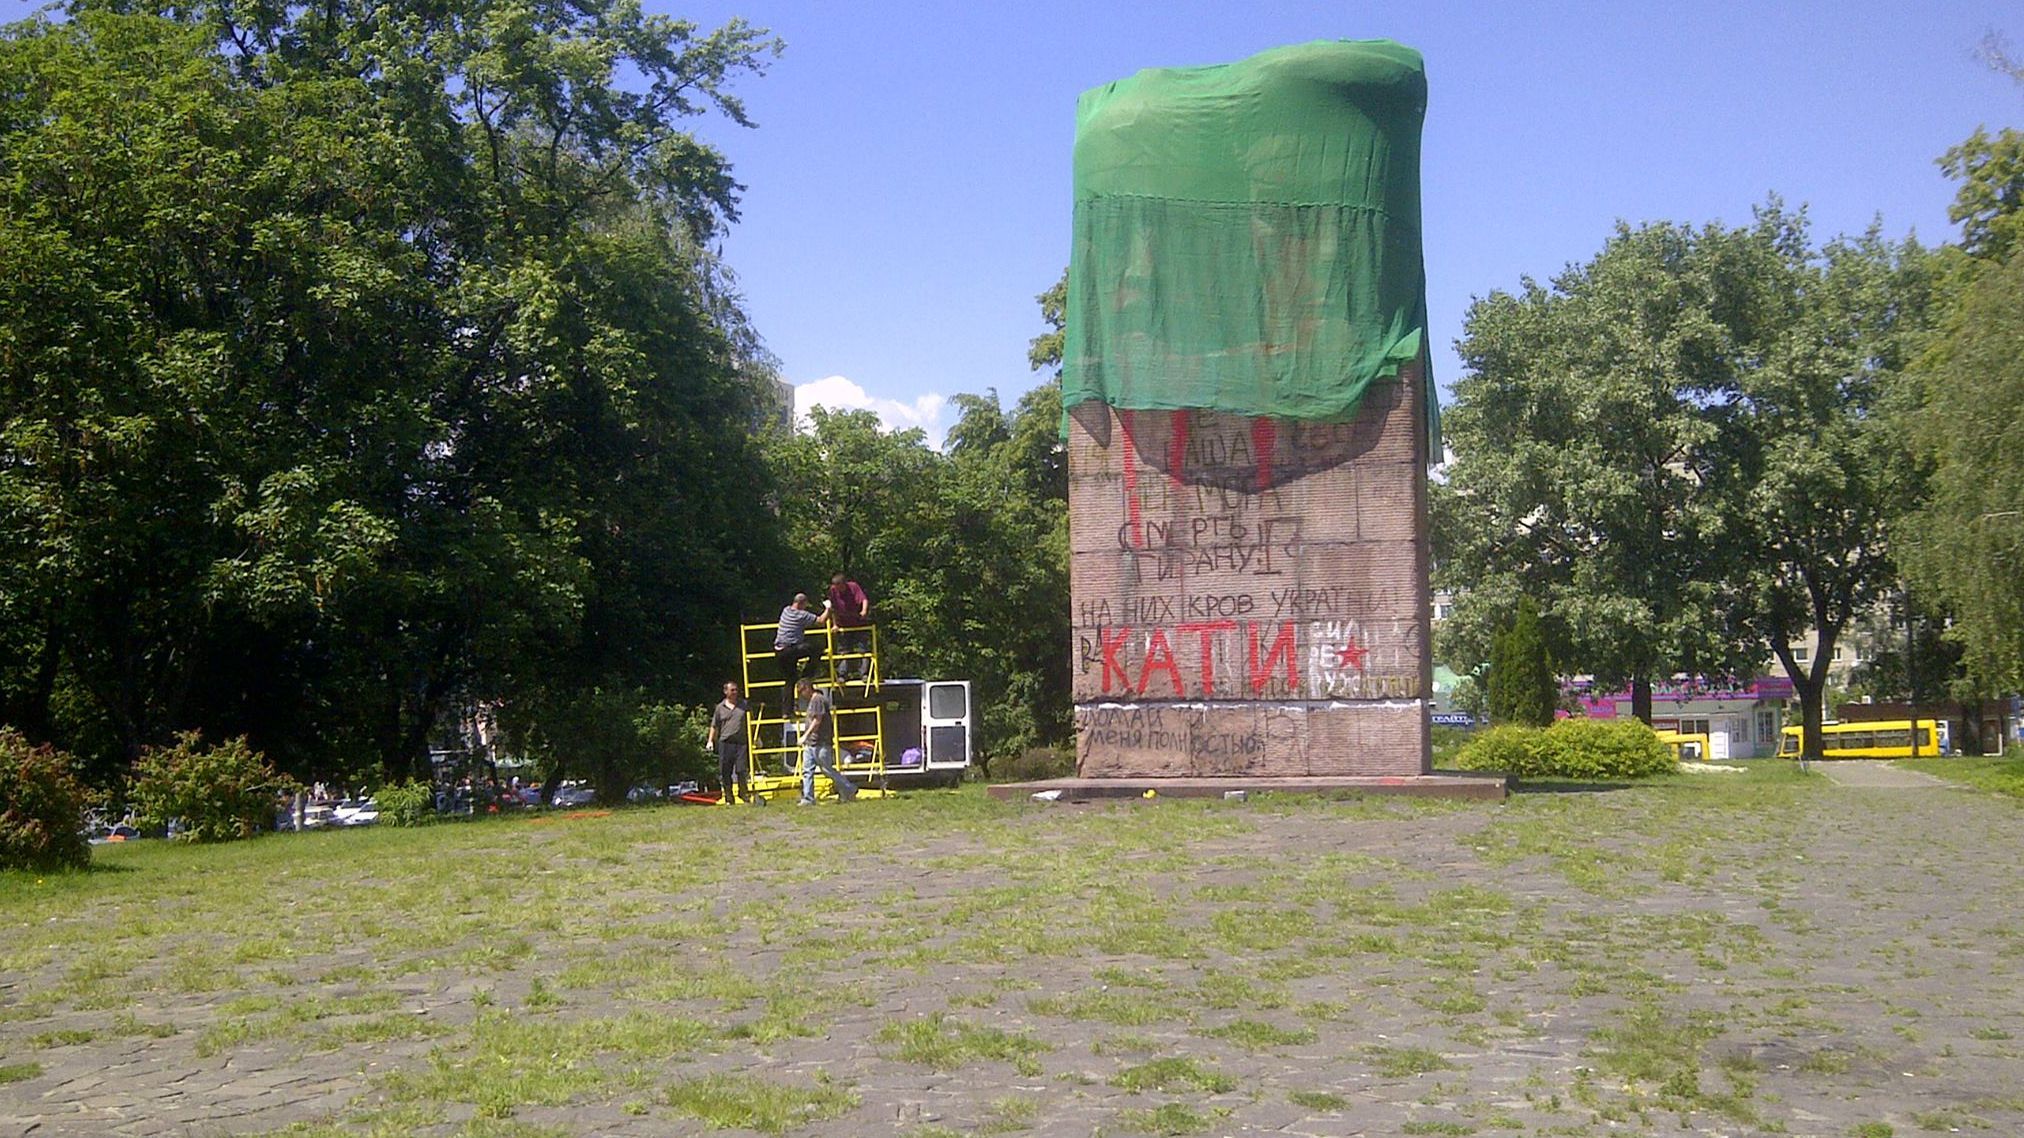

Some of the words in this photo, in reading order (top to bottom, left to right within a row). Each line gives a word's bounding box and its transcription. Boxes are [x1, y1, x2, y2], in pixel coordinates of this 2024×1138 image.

[1080, 597, 1113, 629] НА
[1124, 595, 1176, 624] НИХ
[1187, 593, 1255, 618] КРОВ
[1101, 617, 1301, 699] КАТИ
